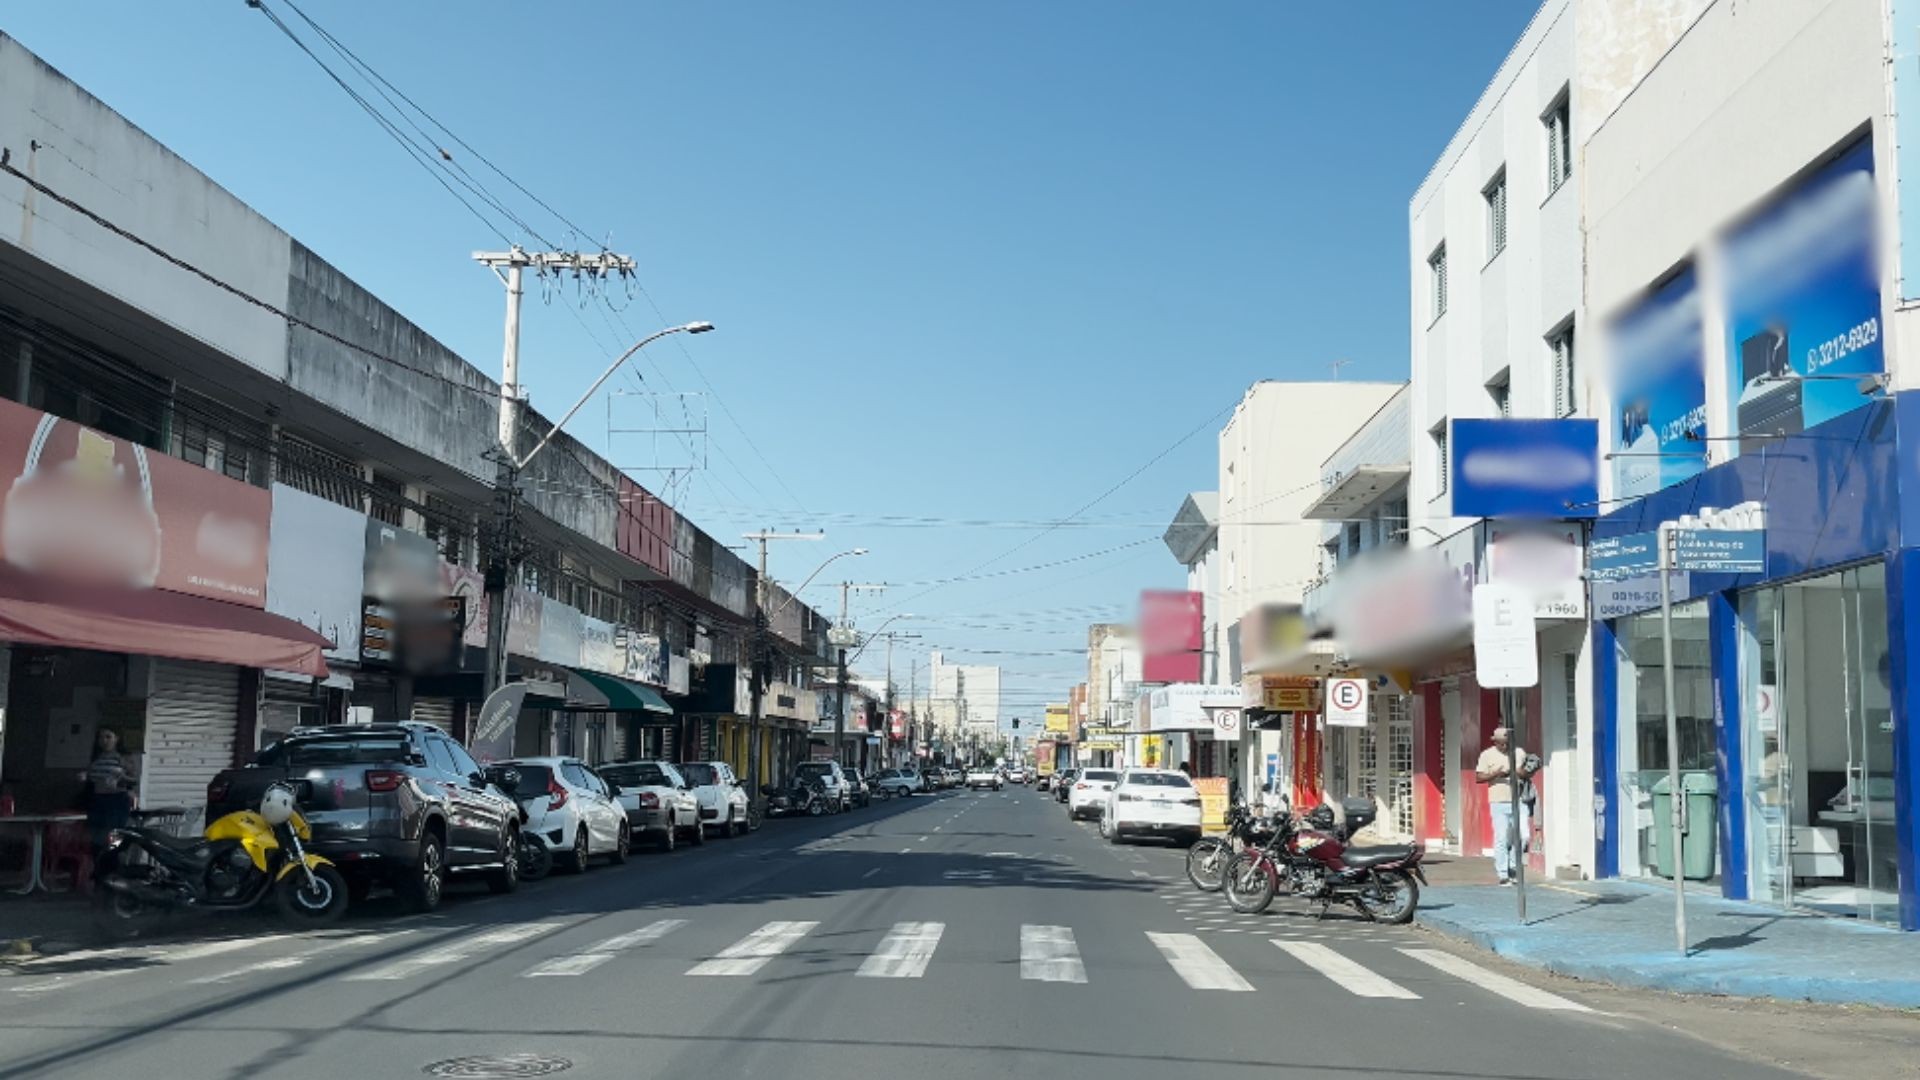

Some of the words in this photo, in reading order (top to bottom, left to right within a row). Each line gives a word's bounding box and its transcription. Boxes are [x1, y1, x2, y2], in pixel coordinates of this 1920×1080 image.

[1819, 317, 1878, 367] 3212-6929
[1341, 686, 1353, 704] E
[1222, 714, 1231, 727] E
